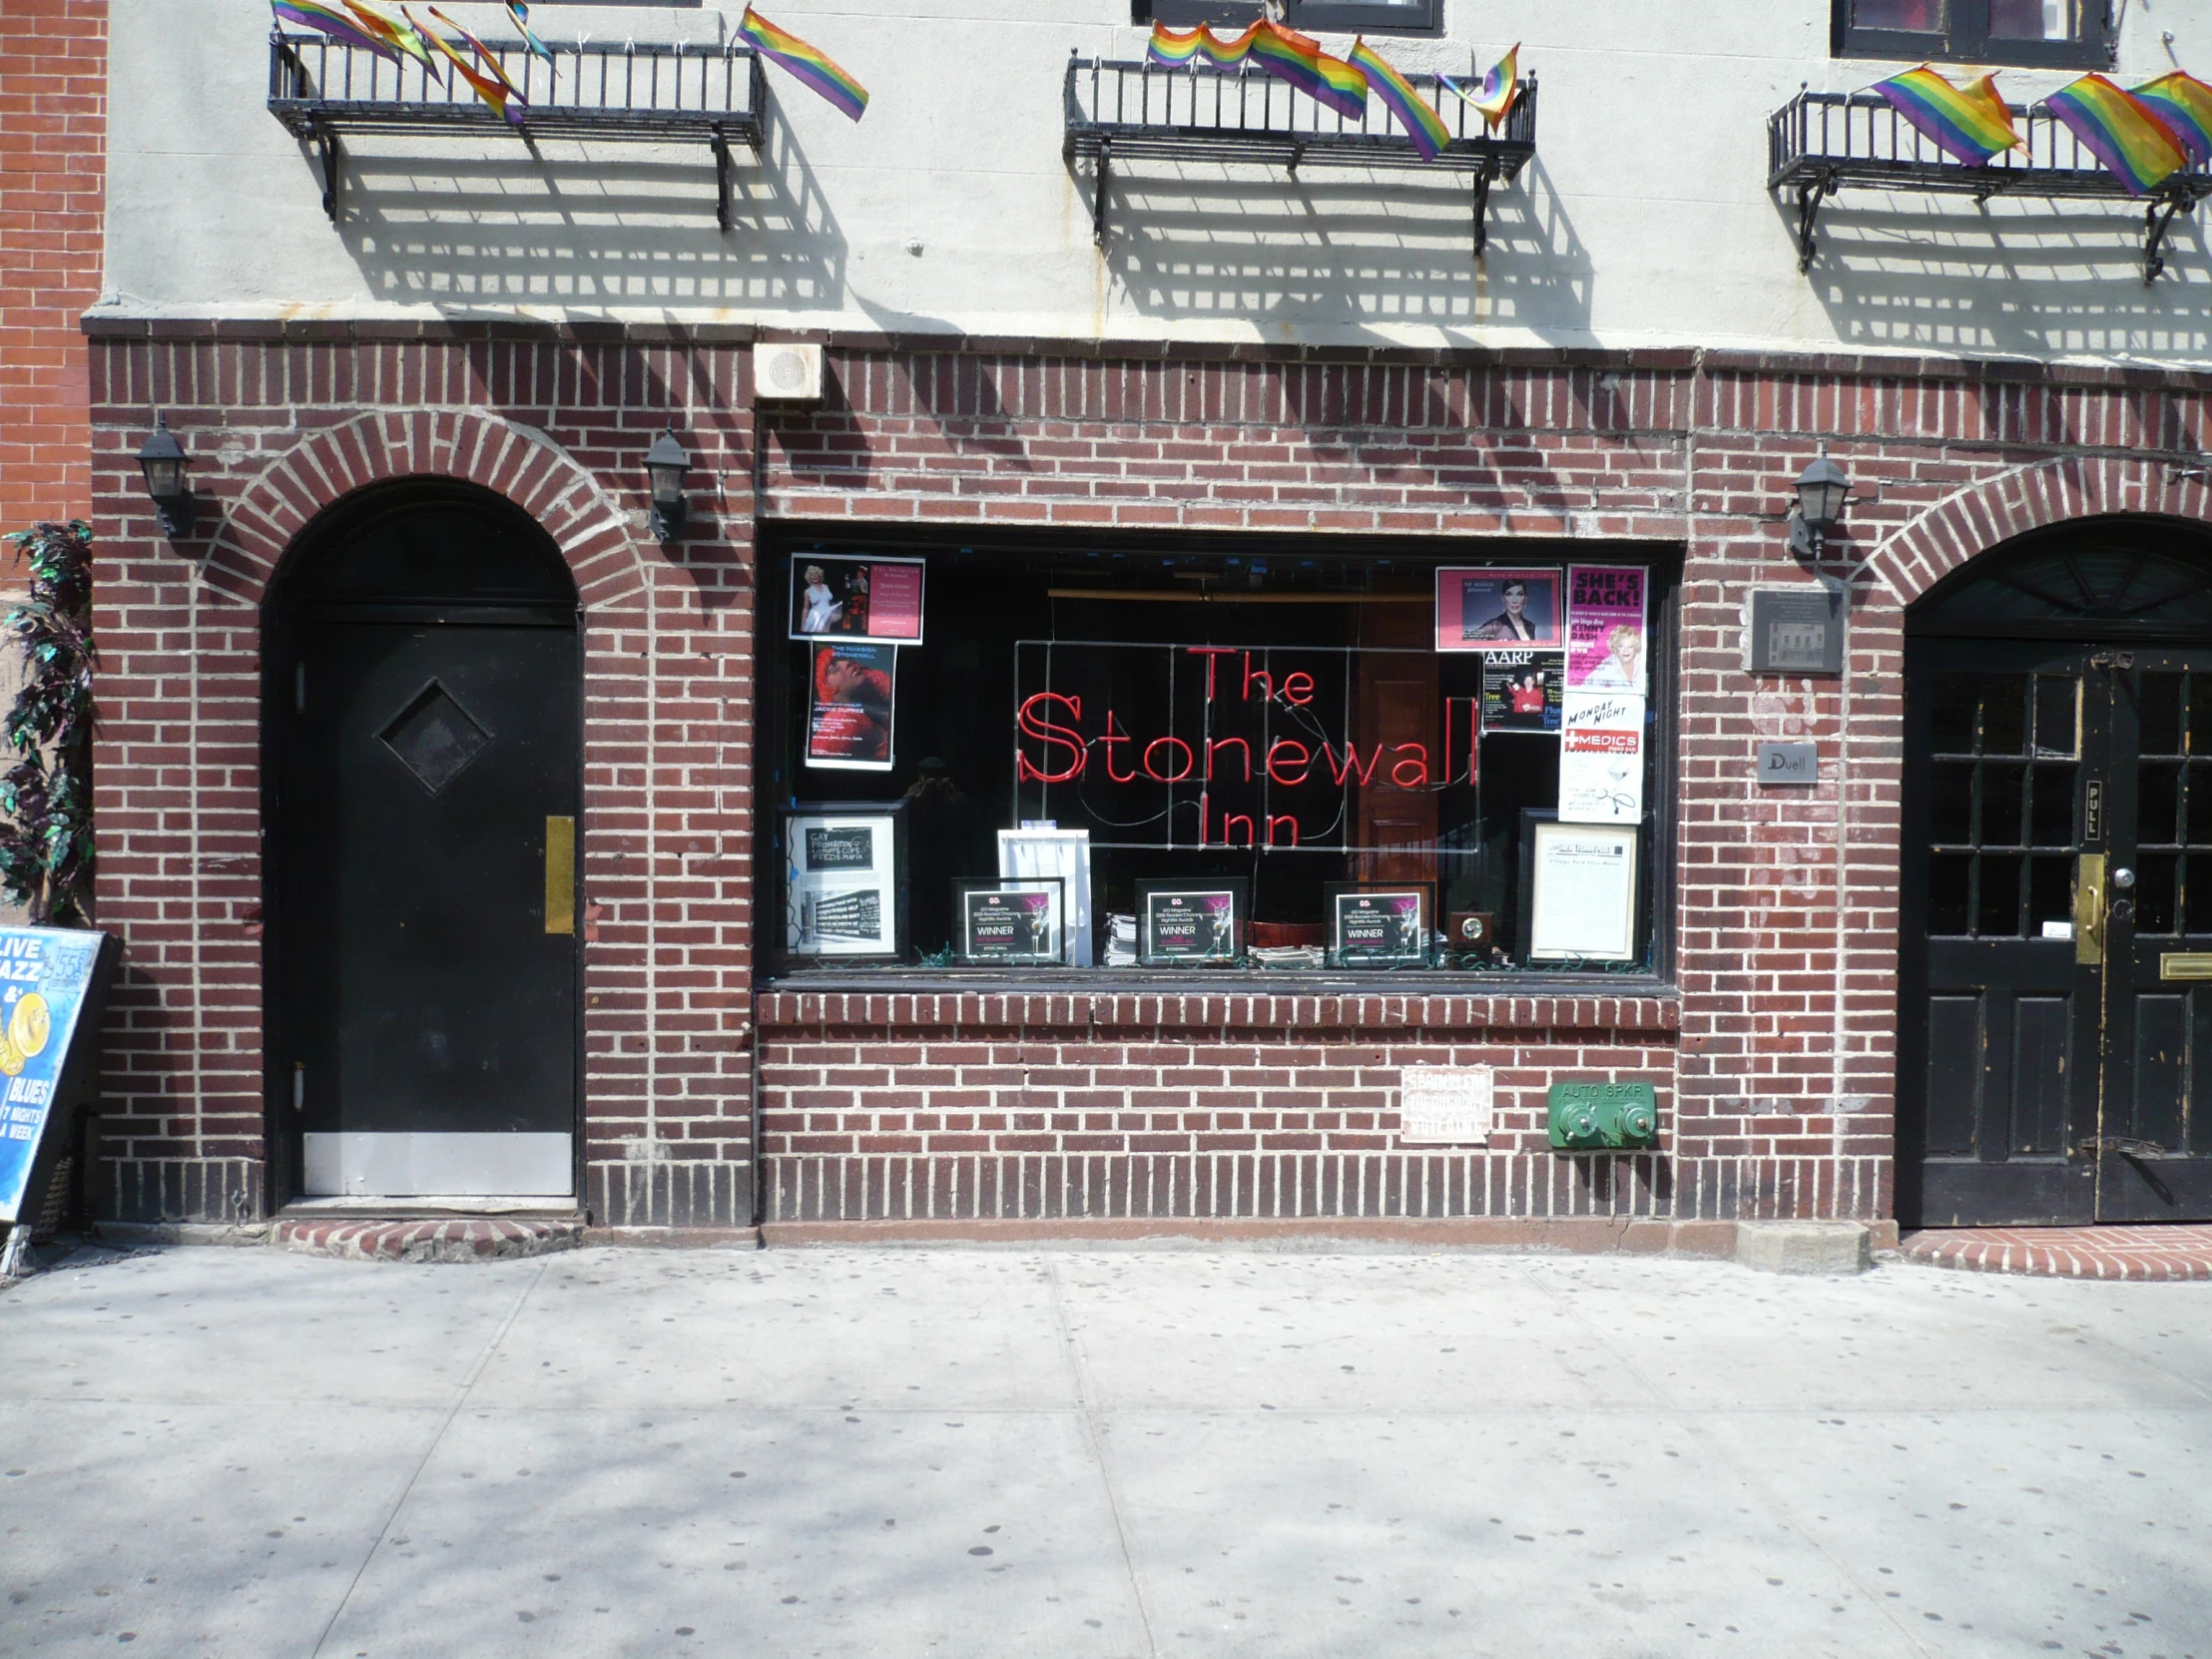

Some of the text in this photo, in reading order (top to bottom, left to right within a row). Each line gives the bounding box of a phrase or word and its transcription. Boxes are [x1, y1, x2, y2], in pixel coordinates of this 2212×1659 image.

[1576, 572, 1639, 589] SHE'S
[1573, 589, 1640, 607] BACK!
[1571, 624, 1605, 633] KENNY
[1484, 651, 1534, 666] AARP
[1187, 647, 1315, 706] The
[1567, 700, 1613, 727] MONDAY
[1593, 707, 1627, 726] NIGHT
[1017, 692, 1477, 787] Stonewall
[1578, 735, 1637, 747] MEDICS
[1768, 753, 1806, 770] Duell
[2089, 788, 2098, 833] PULL
[1200, 792, 1299, 848] Inn
[977, 925, 1014, 935] WINNER
[1159, 925, 1196, 935] WINNER
[1348, 929, 1383, 938] WINNER
[0, 959, 43, 982] AZZ
[9, 1077, 50, 1105] BLUES
[1562, 1085, 1643, 1098] AUTO SPKR
[3, 1106, 42, 1124] 7 NIGHTS
[9, 1124, 35, 1141] WEEK
